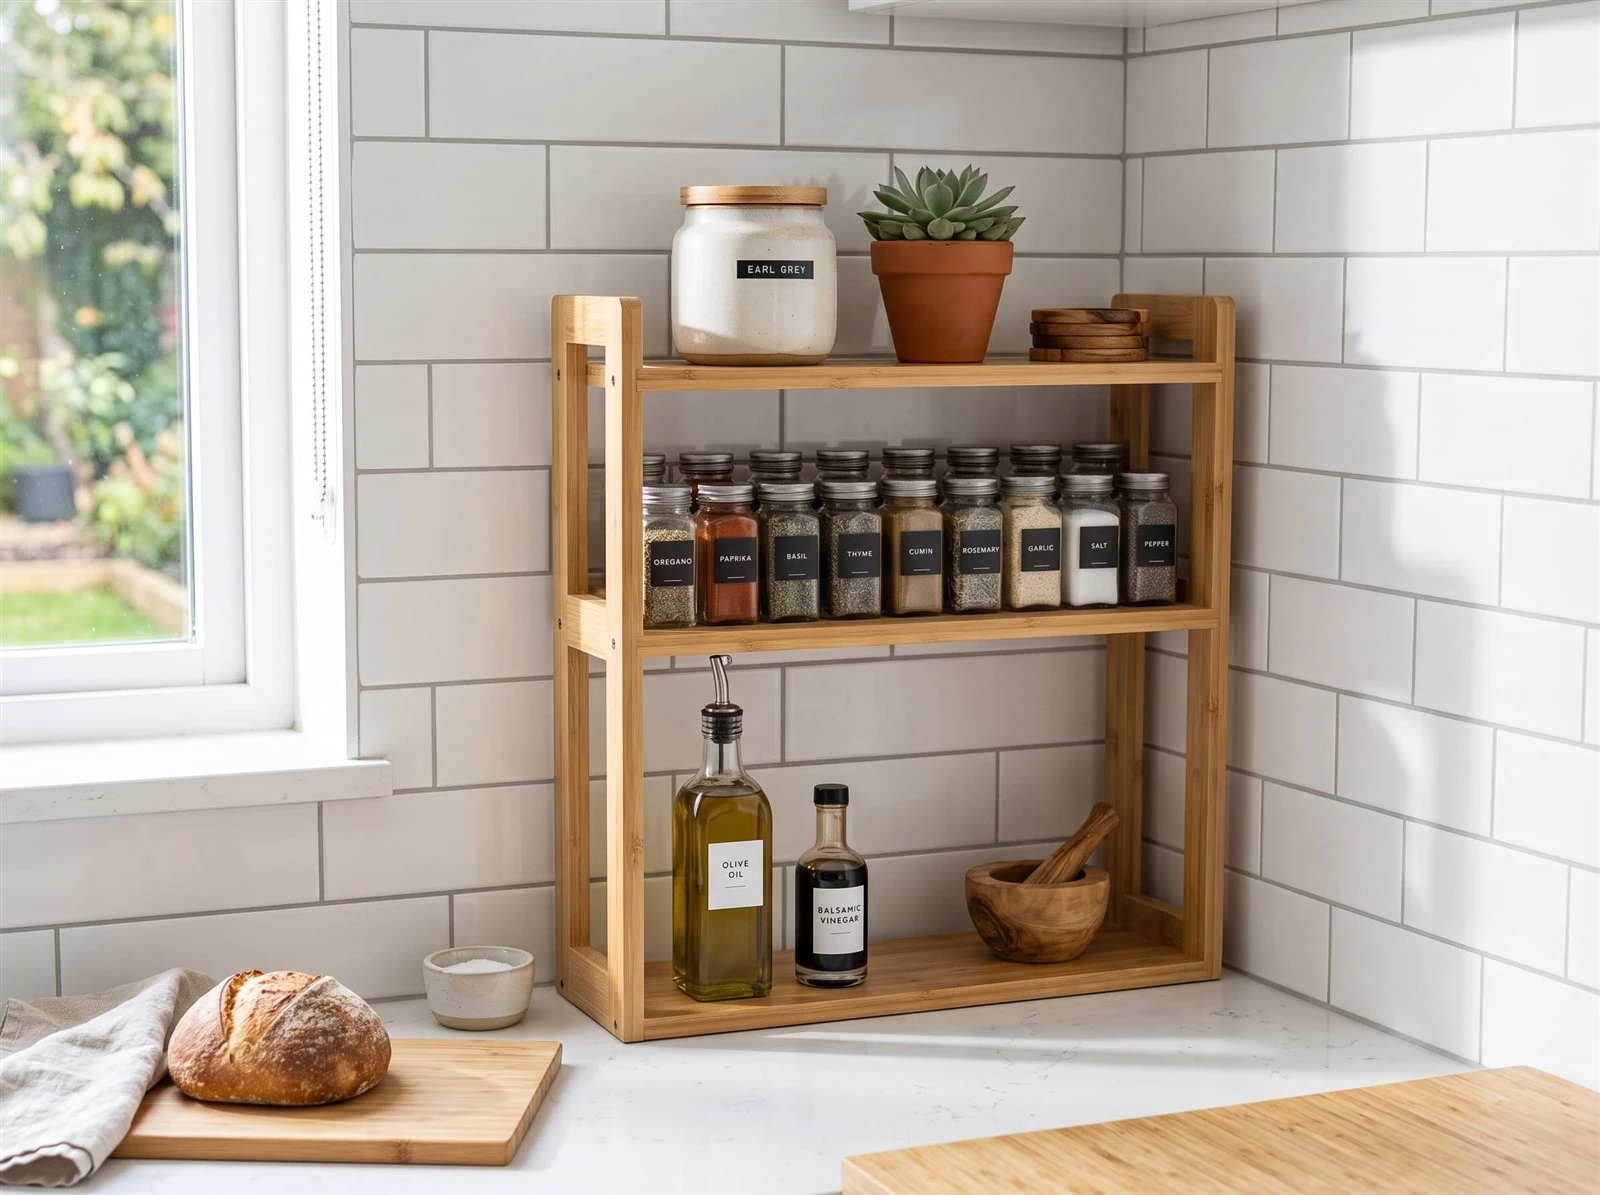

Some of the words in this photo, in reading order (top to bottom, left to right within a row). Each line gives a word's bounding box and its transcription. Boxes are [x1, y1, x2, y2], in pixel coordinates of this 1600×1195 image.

[747, 265, 776, 274] EARL
[780, 265, 806, 274] GREY
[1090, 541, 1108, 550] SALT
[1143, 539, 1170, 548] PEPPER
[908, 547, 934, 556] CUMIN
[962, 546, 1000, 555] ROSEMARY
[1027, 544, 1054, 553] GARLIC
[786, 552, 808, 560] BASIL
[846, 549, 873, 558] THYME
[653, 557, 693, 566] OREGANO
[719, 554, 752, 563] PAPRIKA
[722, 859, 749, 868] OLIVE
[728, 871, 744, 879] OIL
[817, 904, 861, 914] BALSAMIC
[820, 915, 860, 924] VINEGAR
